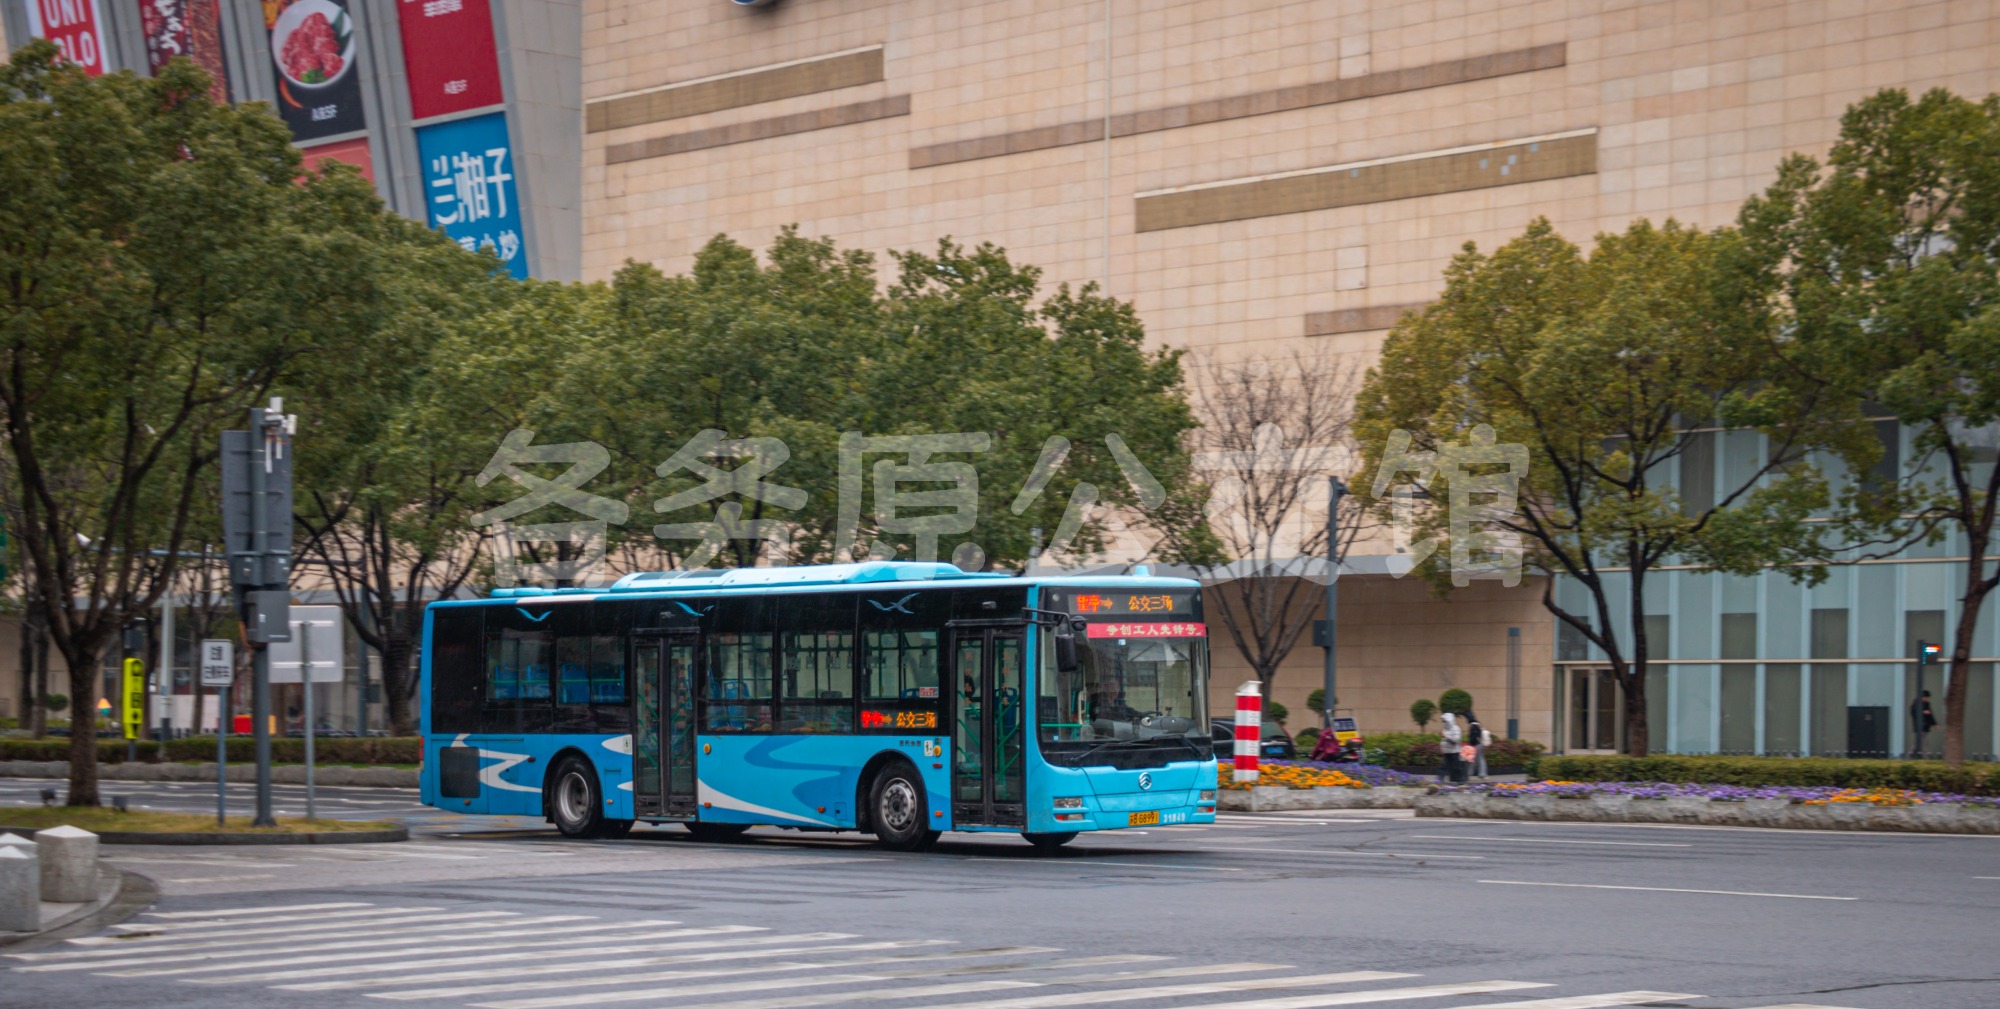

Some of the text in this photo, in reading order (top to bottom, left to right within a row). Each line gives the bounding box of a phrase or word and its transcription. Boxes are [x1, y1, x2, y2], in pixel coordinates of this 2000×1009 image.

[43, 0, 87, 28] UNI
[432, 147, 512, 225] 兰湘子
[896, 711, 936, 728] 公交三场
